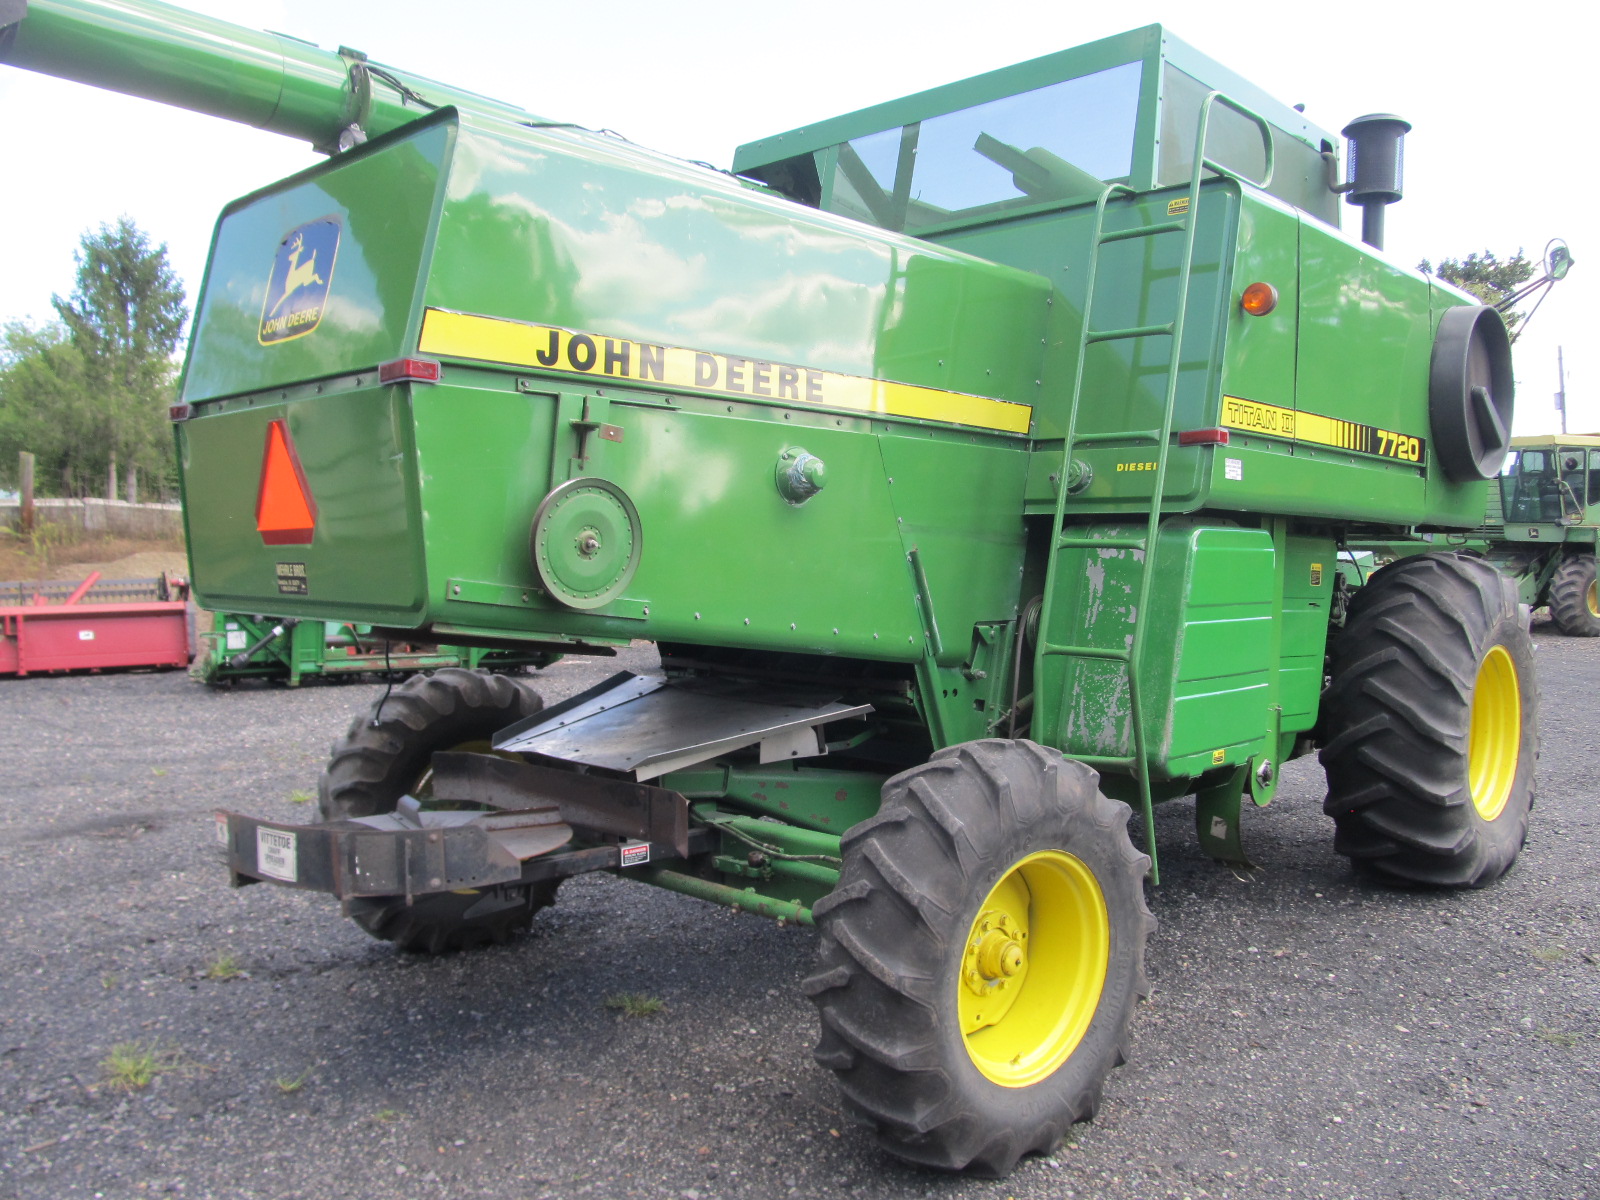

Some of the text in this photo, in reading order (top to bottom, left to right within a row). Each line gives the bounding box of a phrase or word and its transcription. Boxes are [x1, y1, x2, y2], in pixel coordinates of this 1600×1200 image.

[263, 307, 319, 335] JOHN DEERE
[536, 330, 824, 402] JOHN DEERE
[1228, 401, 1294, 434] TITAN II
[1377, 429, 1420, 462] 7720
